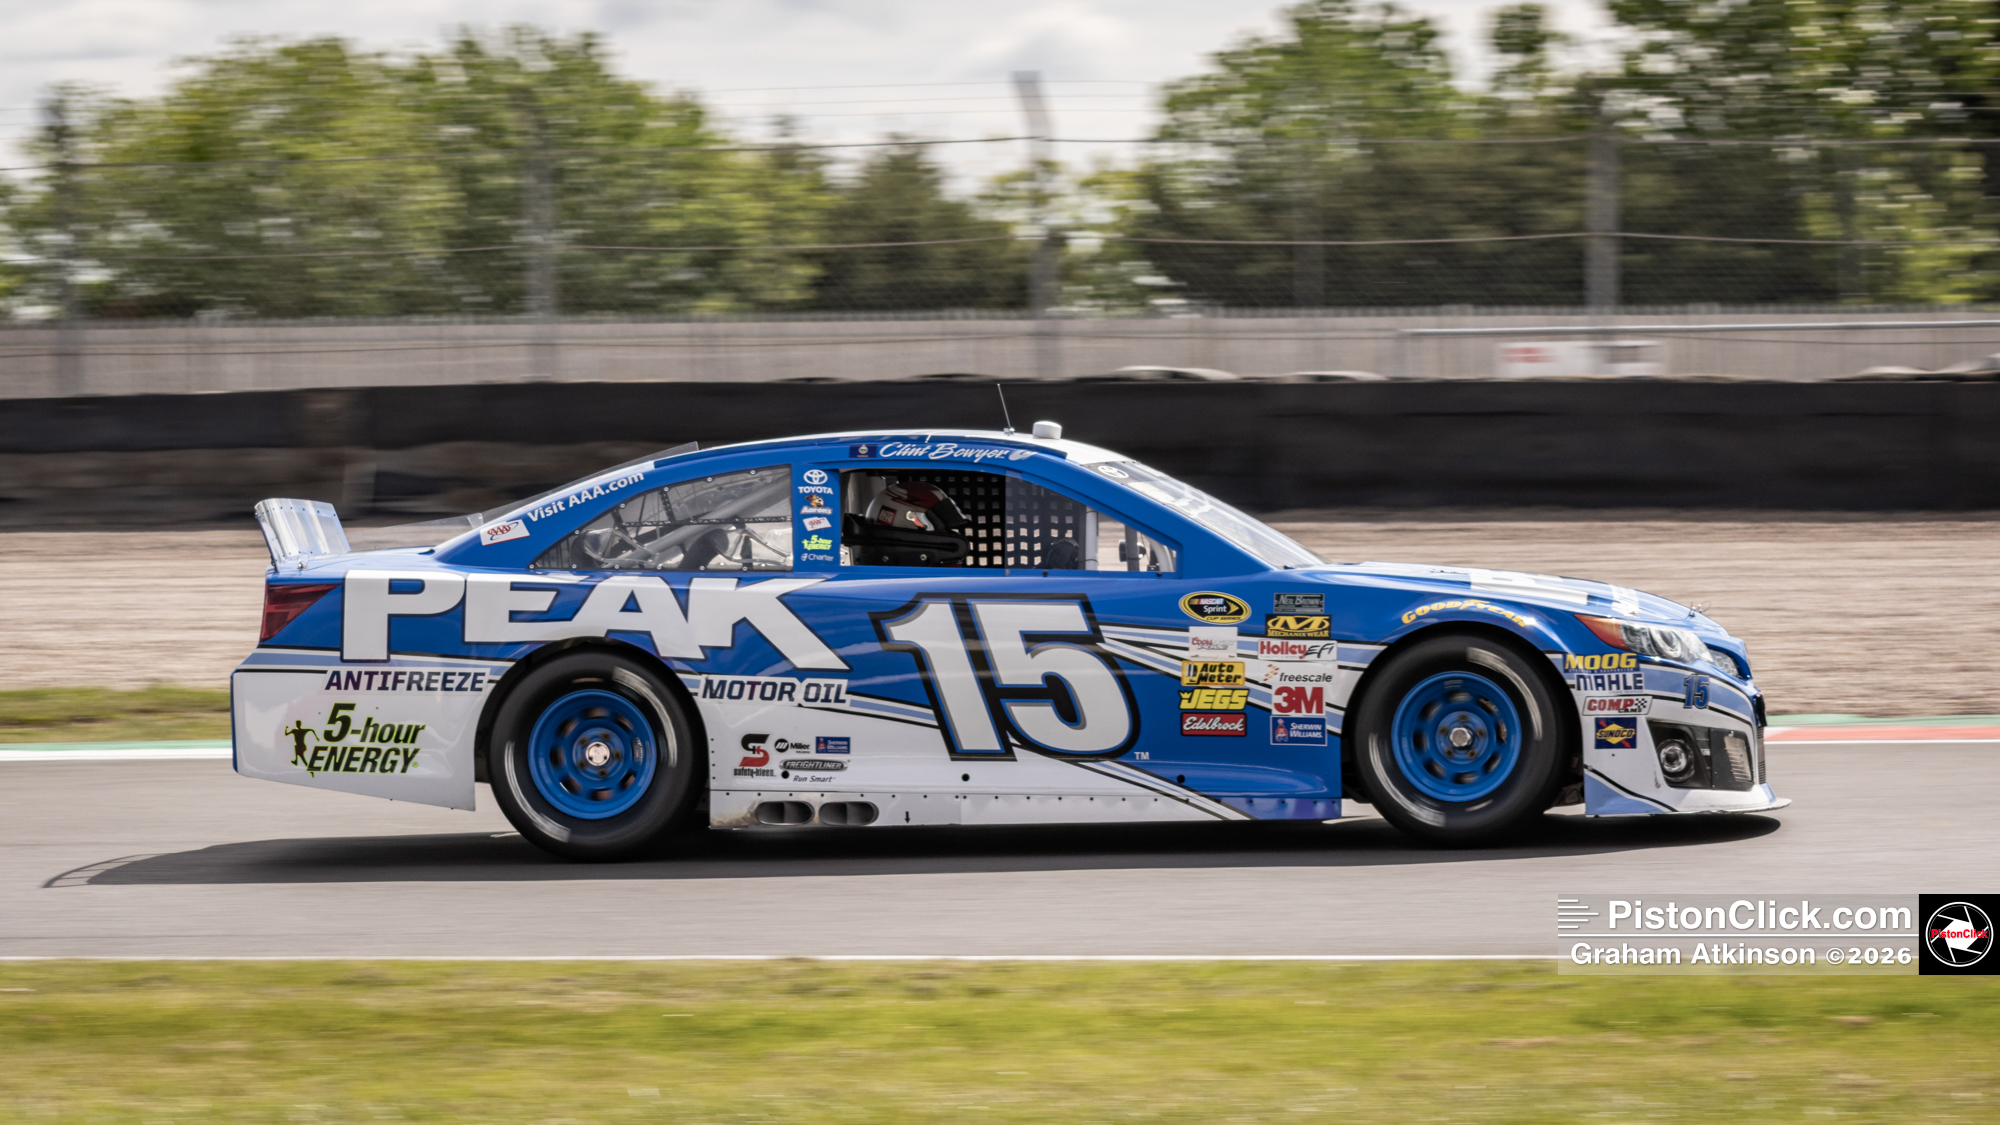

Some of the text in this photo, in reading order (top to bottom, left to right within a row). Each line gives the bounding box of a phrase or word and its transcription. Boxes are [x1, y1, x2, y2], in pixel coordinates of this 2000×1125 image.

[879, 442, 1010, 463] Clint Bowyer
[527, 472, 645, 522] Visit AAA.com
[798, 486, 834, 495] TOYOTA
[487, 524, 511, 537] AAA
[808, 553, 834, 562] Charter
[1203, 605, 1227, 614] Sprint
[343, 568, 851, 671] PEAK
[1307, 630, 1329, 638] WEAR
[1260, 641, 1335, 660] Holley EFI
[1200, 663, 1235, 673] Auto
[1564, 652, 1638, 670] MOOG
[324, 670, 486, 692] ANTIFREEZE
[868, 592, 1141, 762] 15
[1198, 672, 1242, 684] Meter
[1279, 672, 1332, 683] freescale
[1576, 673, 1644, 691] MAHLE
[702, 679, 847, 704] MOTOR OIL
[1683, 674, 1710, 709] 15
[1179, 688, 1250, 711] JEGS
[1273, 686, 1324, 714] 3M
[1587, 699, 1635, 711] COMP
[323, 702, 426, 744] 5-hour
[1183, 716, 1245, 732] Edelbrock
[1597, 729, 1634, 739] SUNOCO
[790, 742, 810, 750] Miller
[306, 745, 421, 774] ENERGY
[1134, 752, 1149, 760] TM
[733, 767, 774, 778] safety-kleen
[785, 761, 842, 770] FREIGHTLINER
[793, 775, 832, 783] Run Smart
